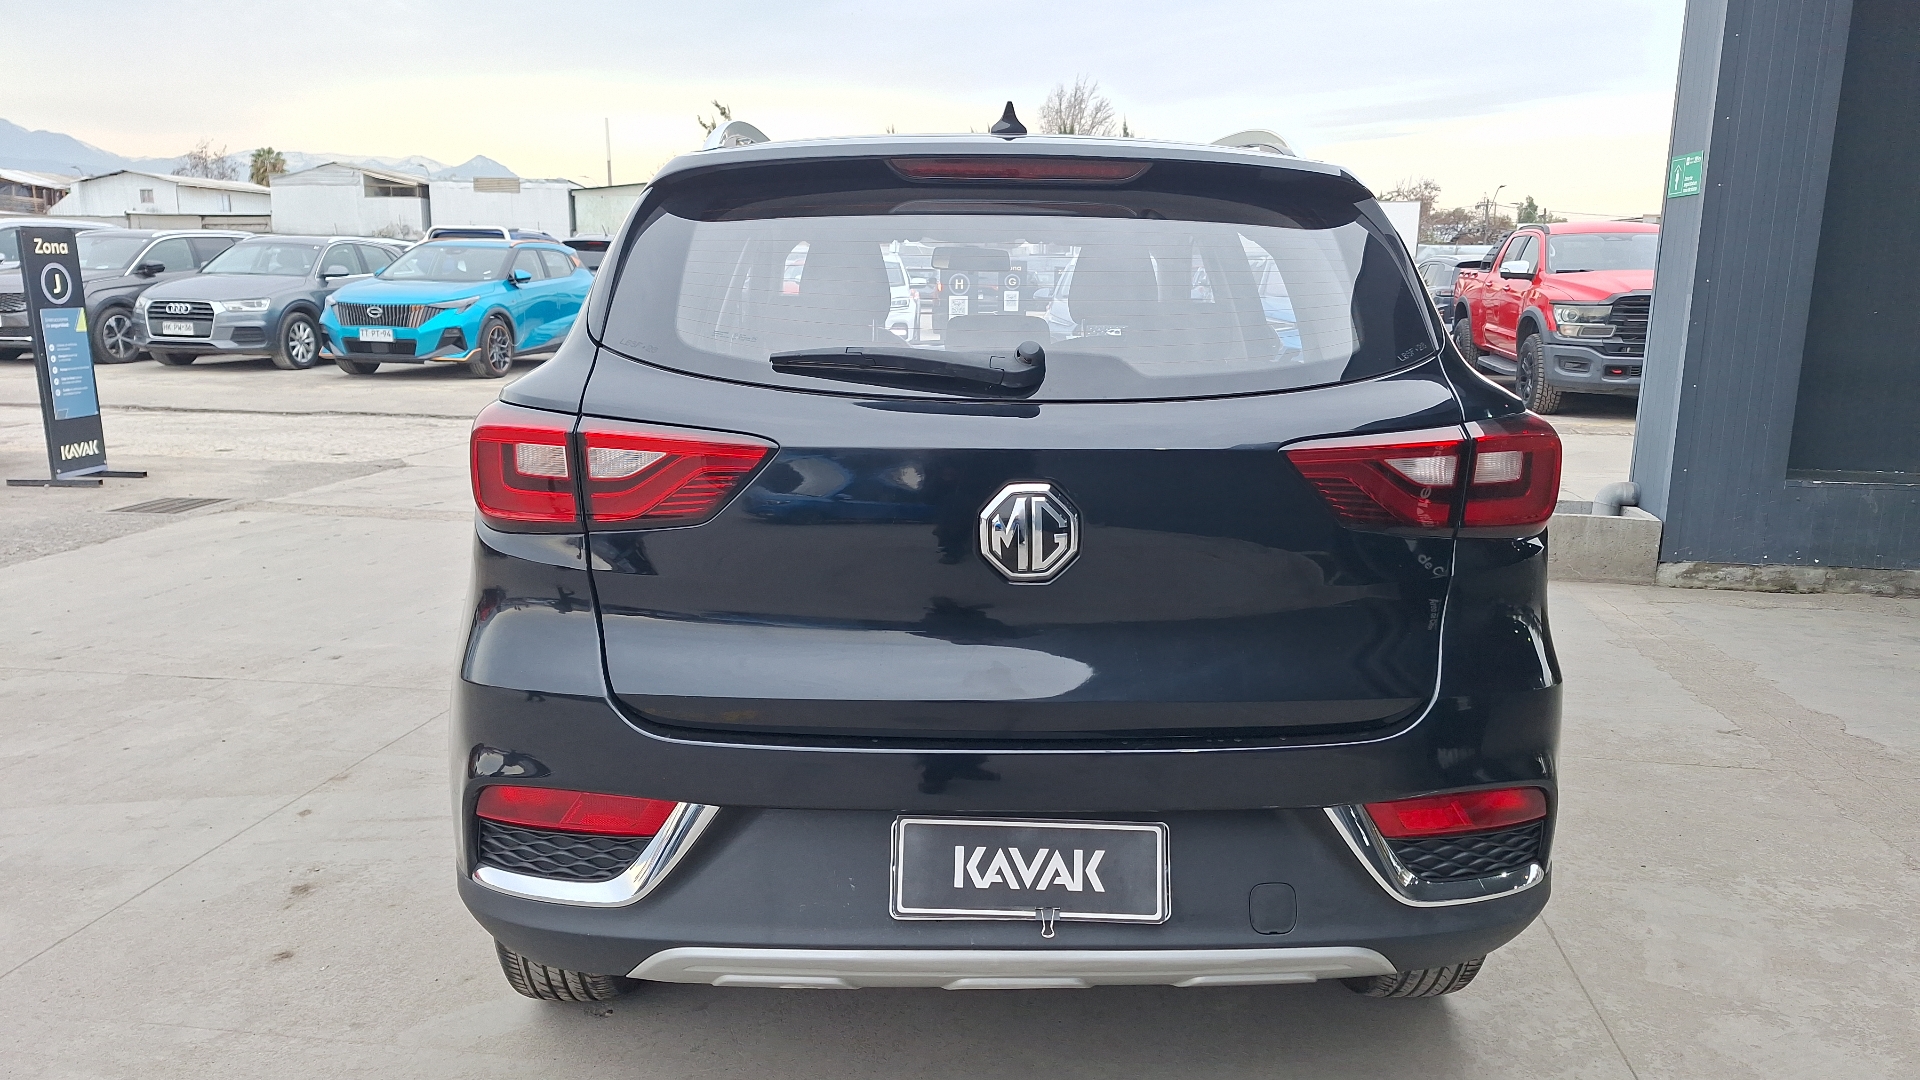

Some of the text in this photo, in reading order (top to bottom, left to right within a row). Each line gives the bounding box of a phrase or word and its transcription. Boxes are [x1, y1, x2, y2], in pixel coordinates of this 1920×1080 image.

[33, 237, 69, 254] Zona
[53, 273, 61, 294] J
[955, 278, 964, 290] H
[1008, 277, 1017, 286] G
[61, 440, 100, 460] KAVAK
[992, 497, 1067, 571] MG
[954, 845, 1106, 893] KAVAK
